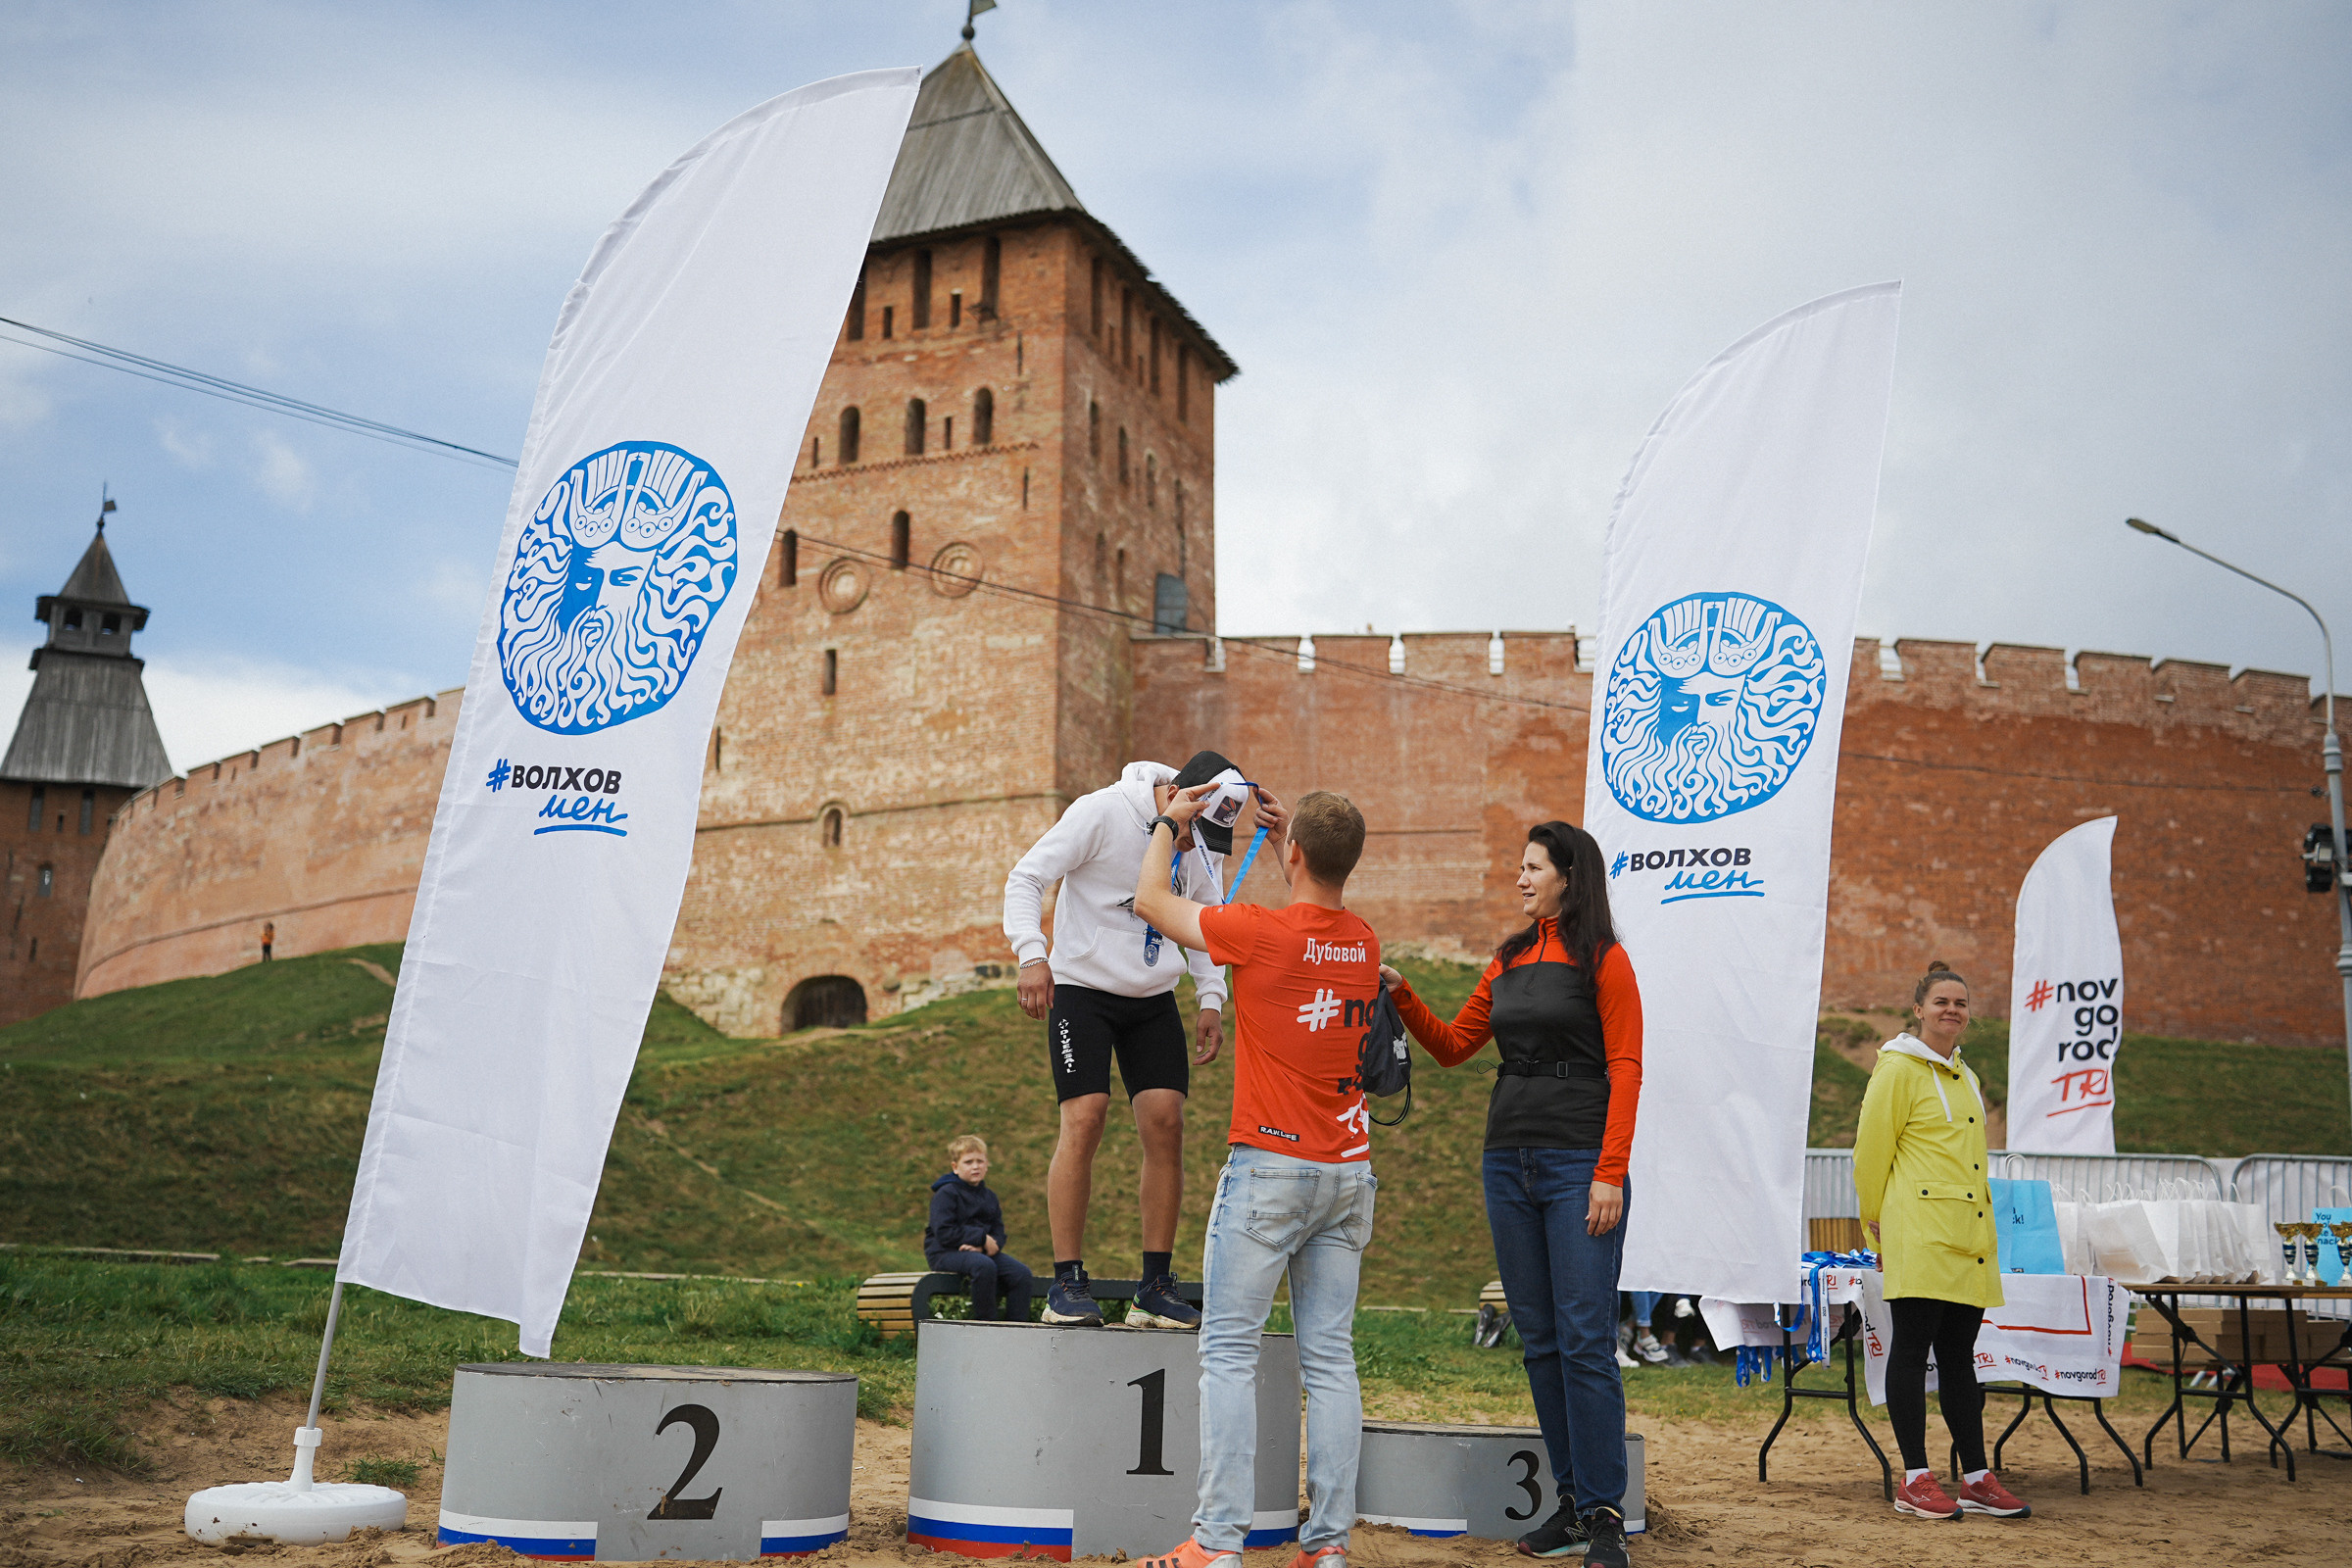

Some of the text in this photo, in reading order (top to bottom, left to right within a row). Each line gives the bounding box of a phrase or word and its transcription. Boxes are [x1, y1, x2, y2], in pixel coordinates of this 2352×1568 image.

[1302, 937, 1367, 966] Дубовой
[2025, 978, 2119, 1012] #nov
[2074, 1004, 2119, 1037] go
[2051, 1066, 2109, 1102] TRI
[2316, 1212, 2331, 1221] You
[2317, 1237, 2340, 1246] nack
[1126, 1369, 1174, 1476] 1
[647, 1403, 723, 1520] 2
[1505, 1449, 1543, 1521] 3
